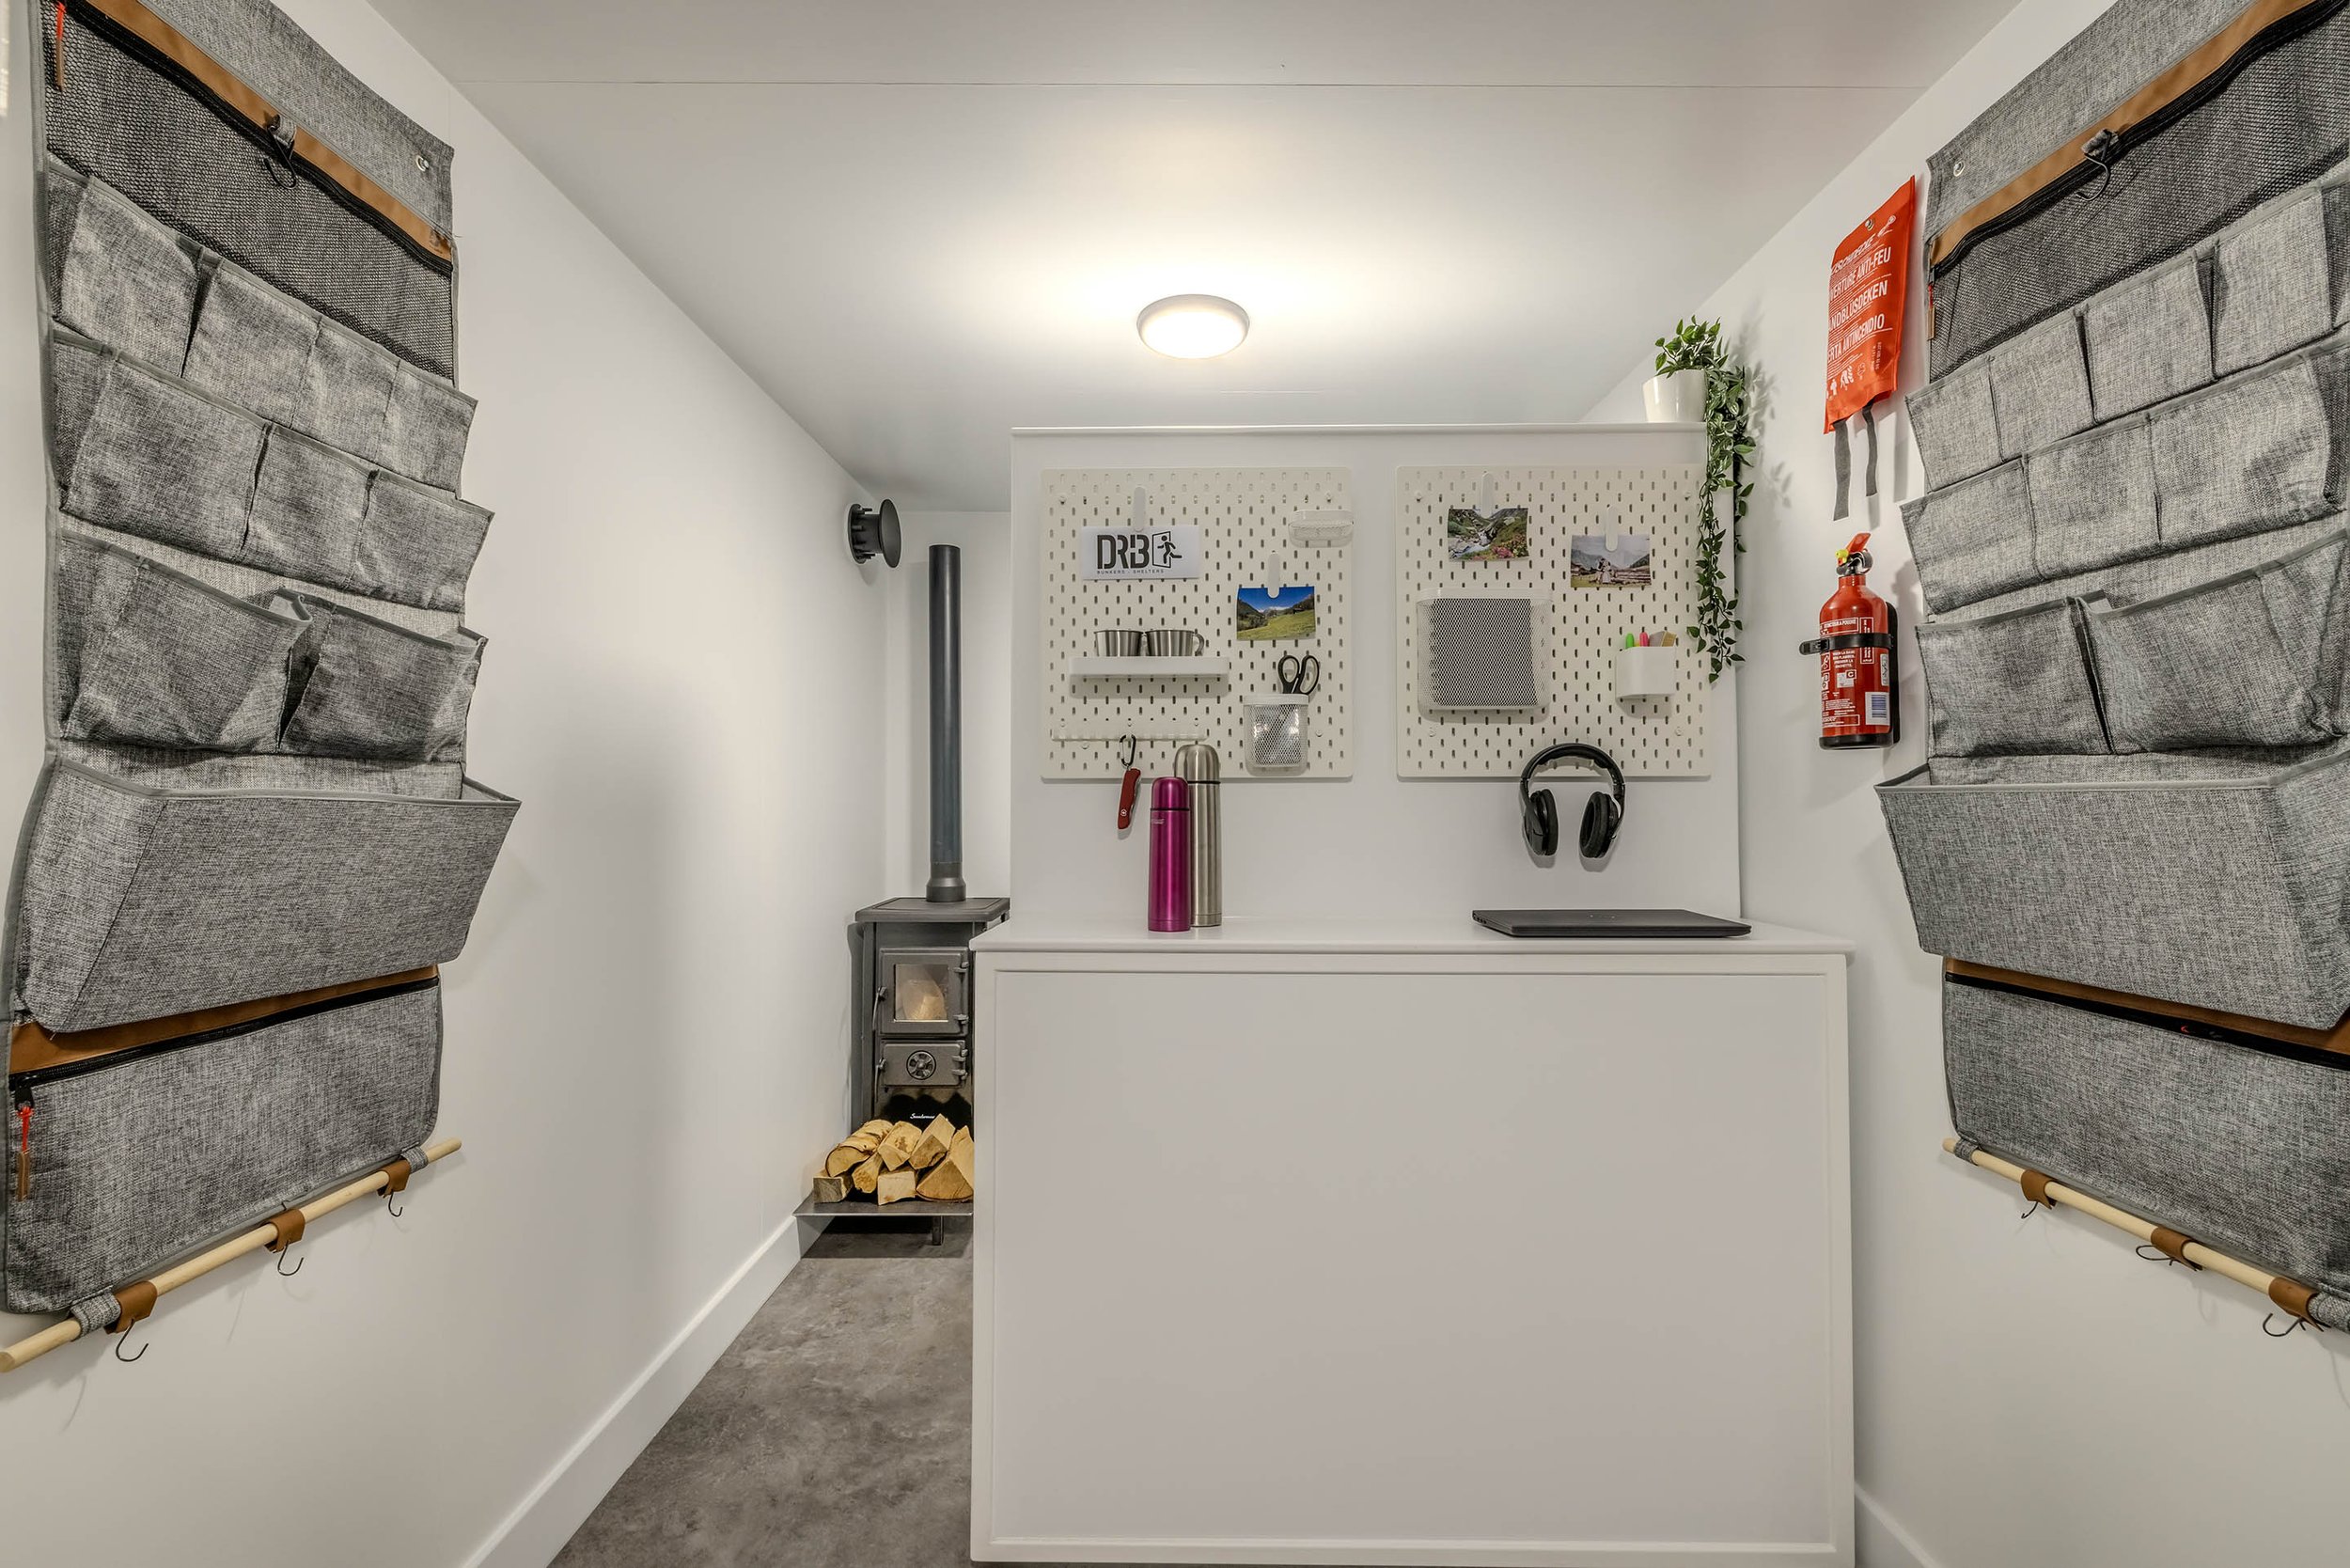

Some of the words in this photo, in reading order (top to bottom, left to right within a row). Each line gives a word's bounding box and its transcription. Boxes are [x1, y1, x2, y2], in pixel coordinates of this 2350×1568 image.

[1856, 246, 1891, 281] ANTI-FEU
[1842, 313, 1885, 353] ANTINCENDIO
[1097, 534, 1150, 569] DRB
